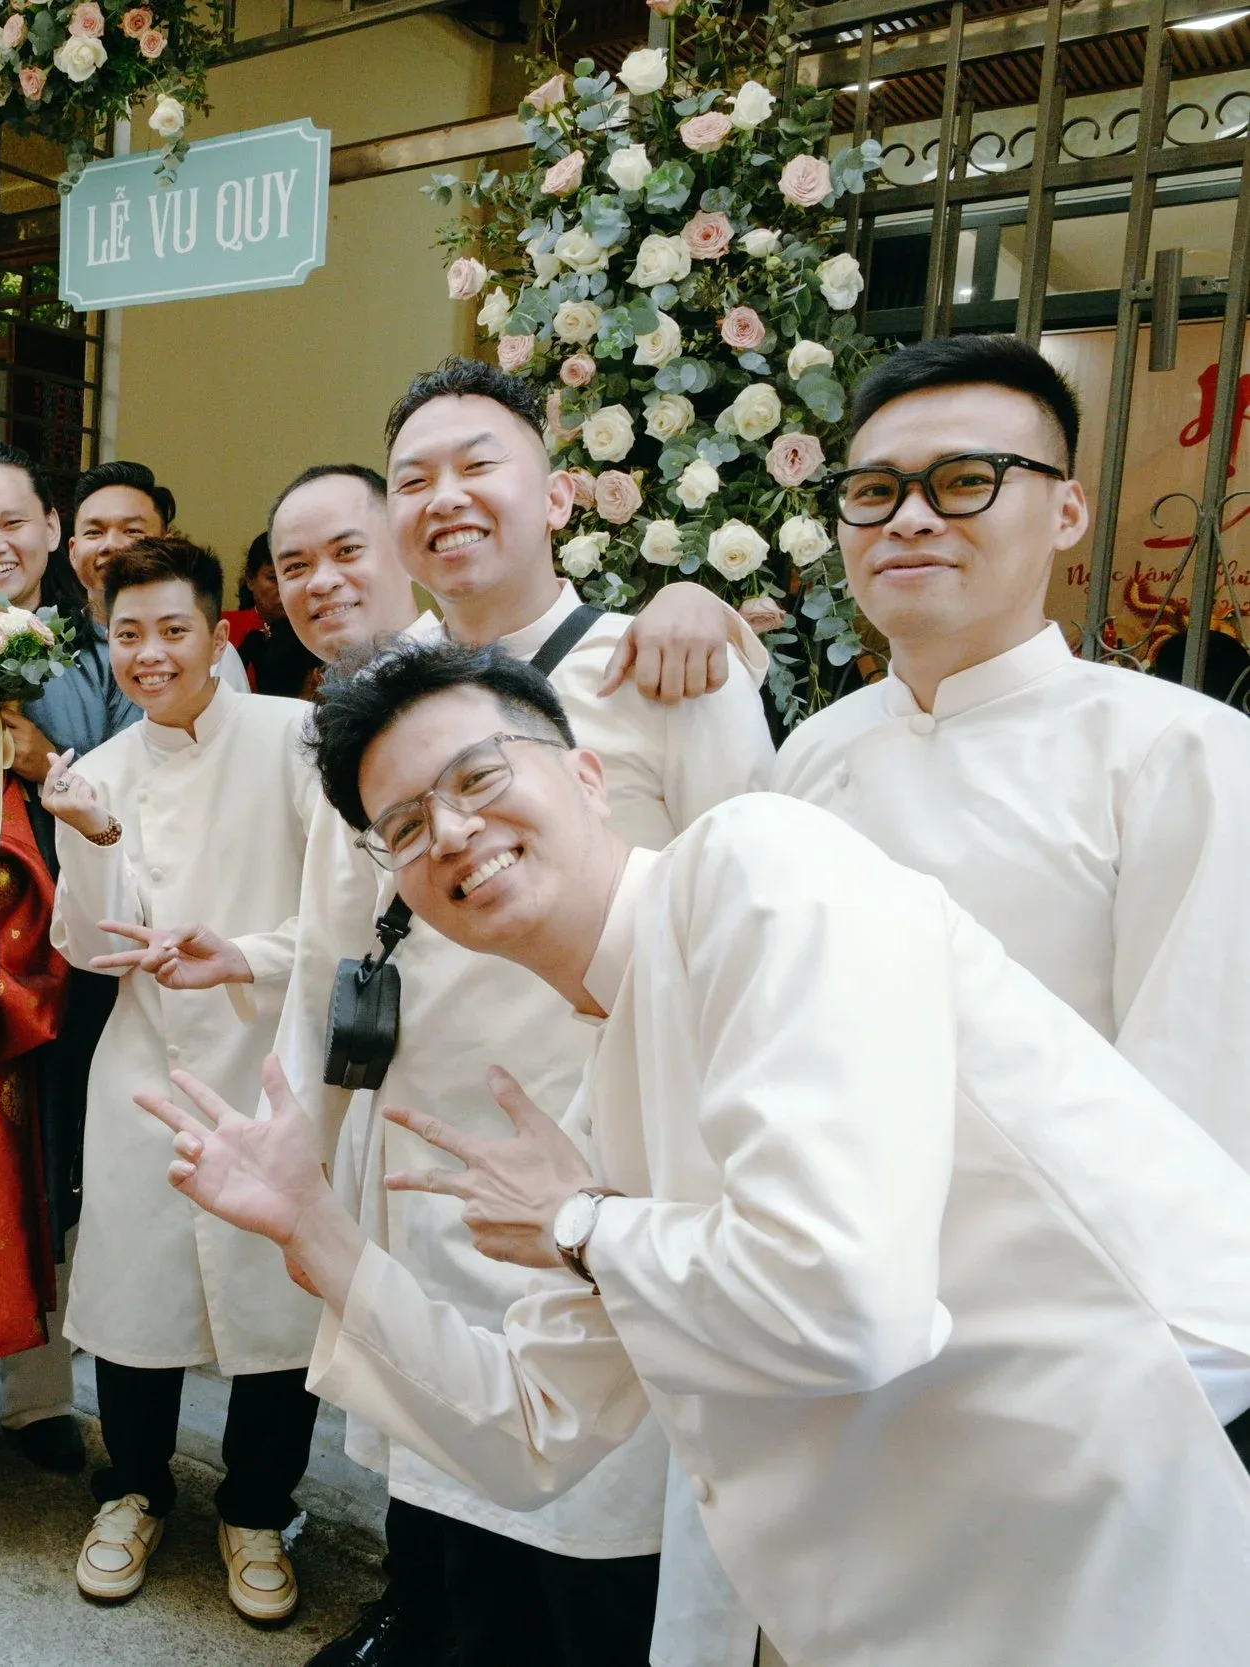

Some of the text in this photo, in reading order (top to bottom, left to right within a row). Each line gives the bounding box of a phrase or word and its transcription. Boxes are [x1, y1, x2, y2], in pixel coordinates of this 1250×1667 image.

[86, 168, 300, 267] LỄ VU QUY
